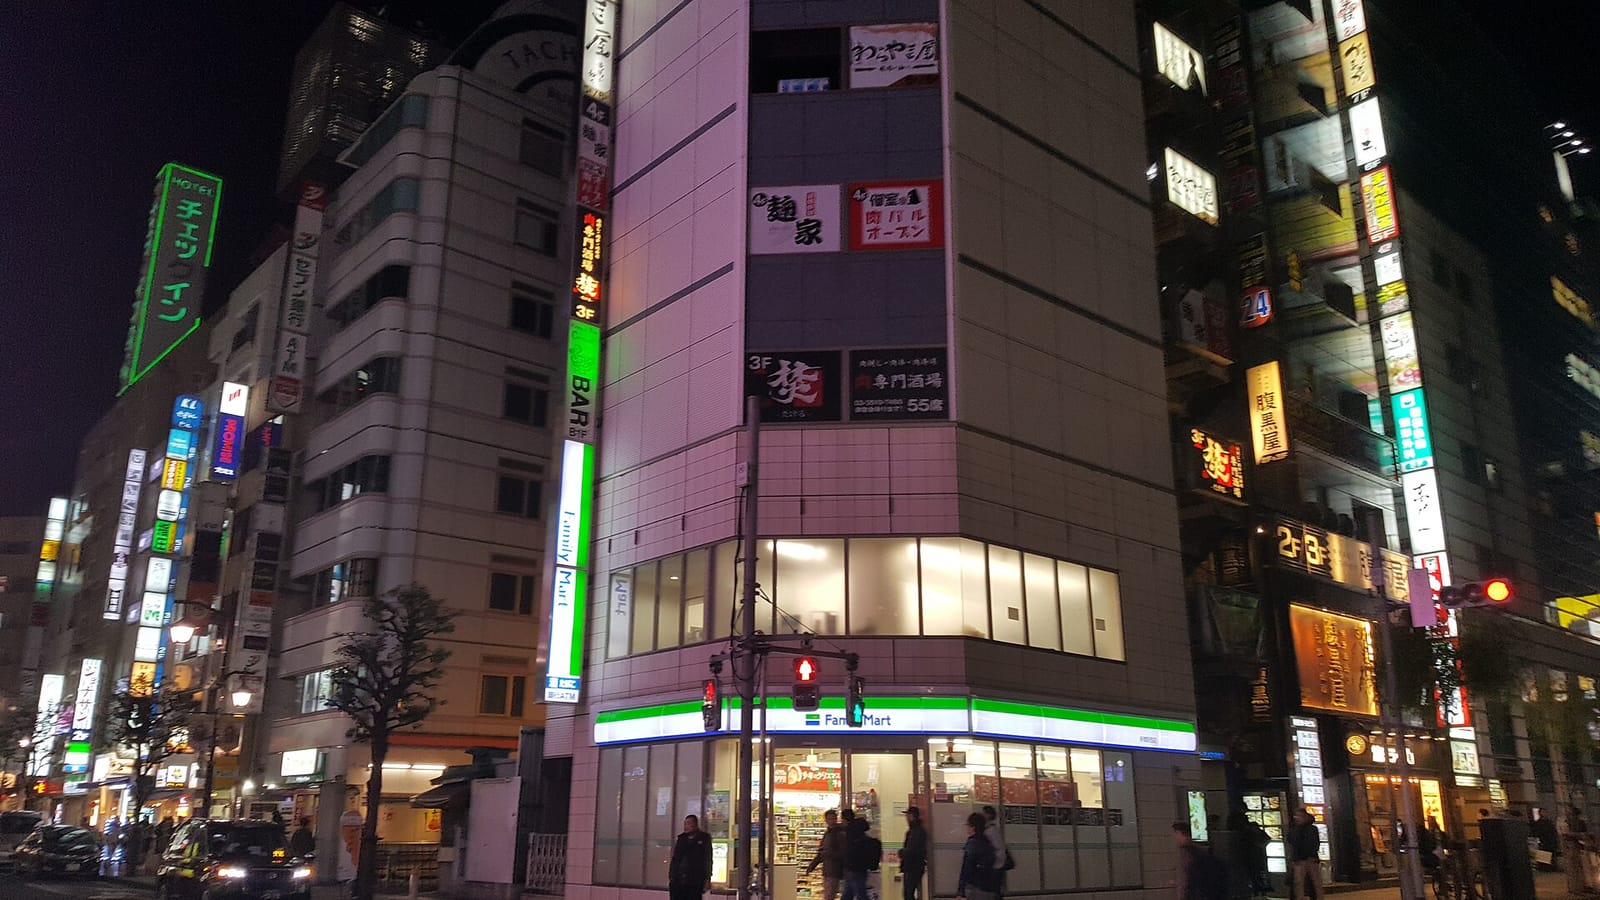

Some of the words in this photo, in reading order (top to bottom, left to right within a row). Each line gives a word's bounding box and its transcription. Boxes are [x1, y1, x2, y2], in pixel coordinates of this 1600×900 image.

[172, 177, 215, 196] HOTEL
[866, 226, 925, 240] オープン
[576, 304, 596, 320] 3F
[1242, 291, 1269, 321] 24
[748, 355, 773, 370] 3F
[569, 374, 591, 428] BAR
[219, 418, 239, 464] PROMISE
[569, 427, 588, 440] B1F
[1277, 526, 1302, 558] 2F
[1305, 534, 1329, 566] 3F
[558, 570, 573, 607] Mart
[72, 730, 90, 742] 2F
